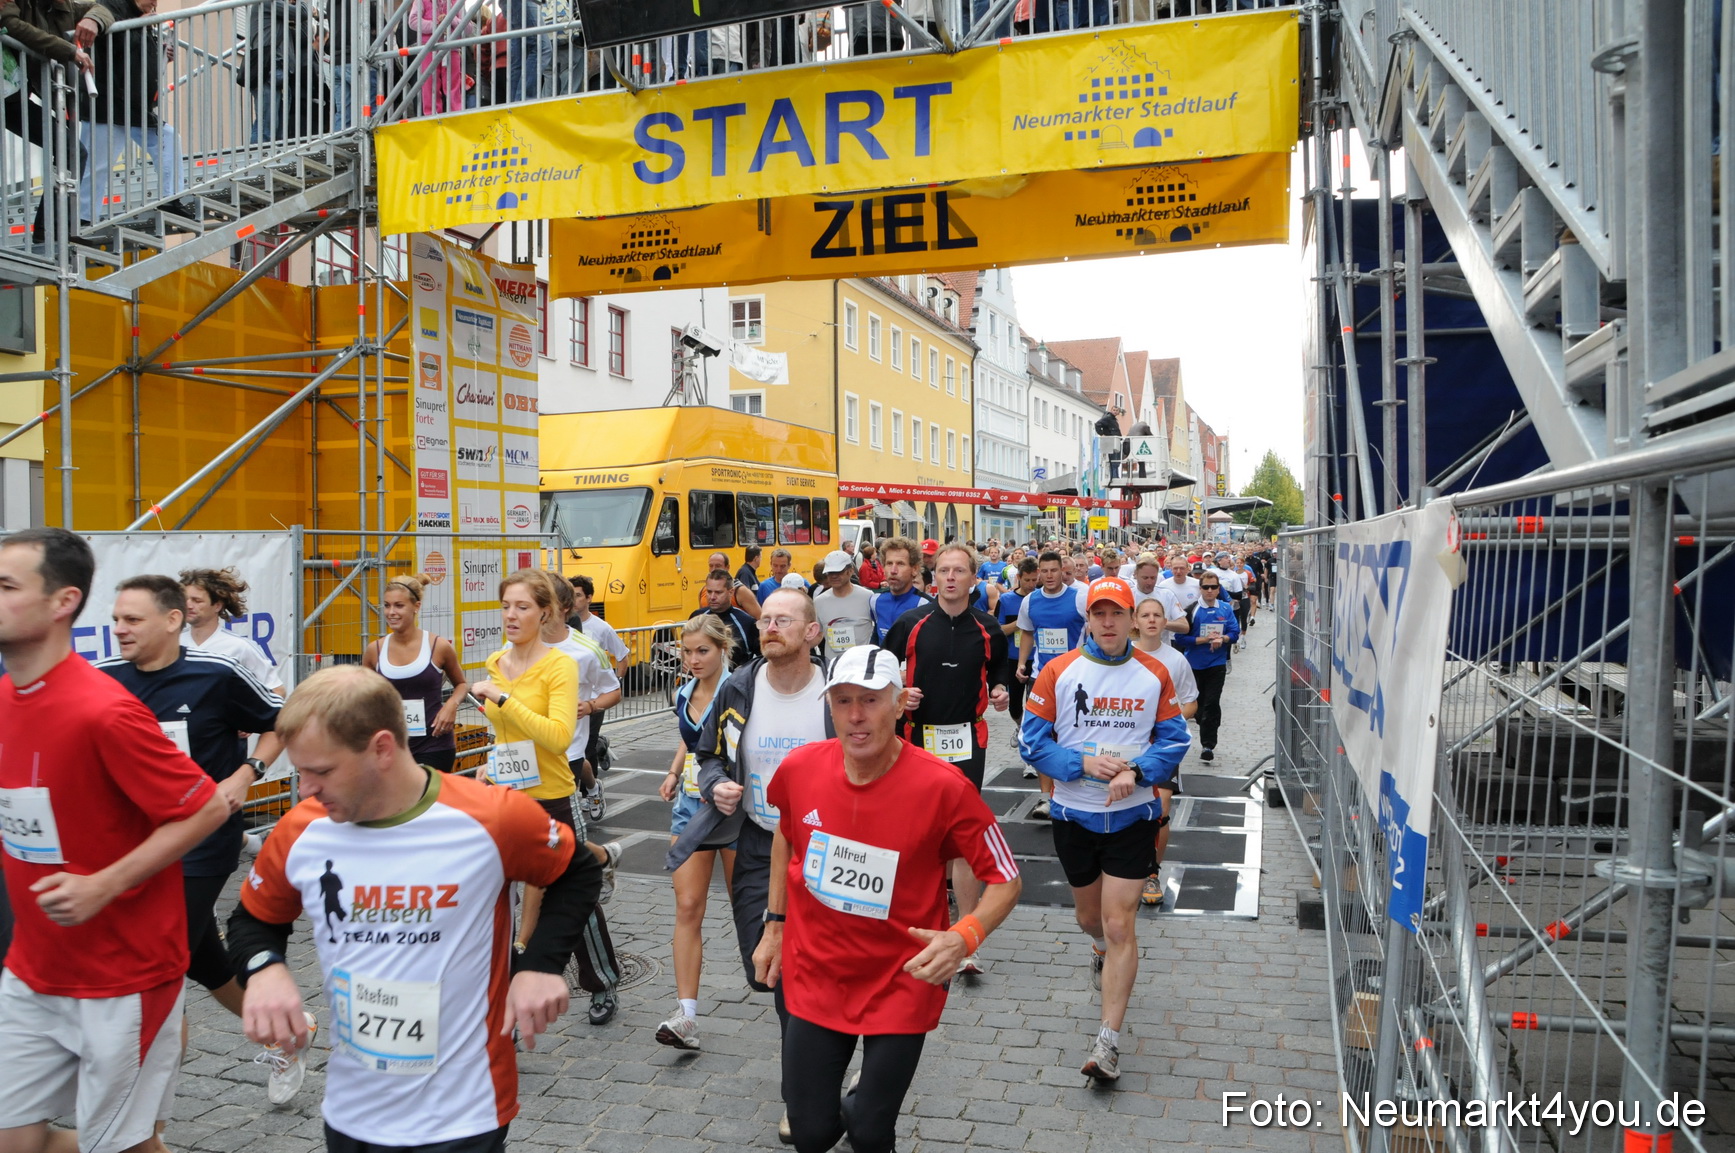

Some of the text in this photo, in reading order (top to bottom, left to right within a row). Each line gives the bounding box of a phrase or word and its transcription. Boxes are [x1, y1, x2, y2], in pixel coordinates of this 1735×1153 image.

[1013, 92, 1239, 131] Neumarkter Stadtlauf
[633, 81, 952, 185] START
[411, 164, 583, 197] Neumarkter Stadtlauf
[1074, 197, 1250, 228] Neumarkter Stadtlauf
[810, 190, 979, 259] ZIEL
[577, 243, 722, 268] Neumarkter Stadtlauf
[495, 278, 537, 299] MERZ
[415, 397, 446, 413] Sinupret
[504, 392, 538, 413] OBI
[416, 412, 434, 425] forte
[505, 448, 529, 464] MCM
[573, 473, 630, 485] TIMING
[786, 476, 799, 487] EVENT
[850, 485, 876, 493] Service
[888, 487, 905, 495] Miet-
[947, 489, 965, 497] 09181
[965, 490, 981, 498] 6352
[418, 519, 451, 528] HACKNER
[463, 560, 499, 577] Sinupret
[465, 578, 485, 592] forte
[836, 636, 850, 644] 489
[1089, 705, 1134, 718] Reisen
[1092, 697, 1146, 712] MERZ
[1083, 720, 1136, 729] TEAM 2008
[941, 738, 964, 750] 510
[497, 759, 530, 775] 2300
[833, 844, 867, 865] Alfred
[811, 859, 818, 869] C
[830, 866, 884, 894] 2200
[353, 884, 460, 910] MERZ
[349, 901, 433, 924] Reisen
[343, 930, 442, 945] TEAM 2008
[356, 983, 399, 1008] Stefan
[358, 1012, 425, 1043] 2774
